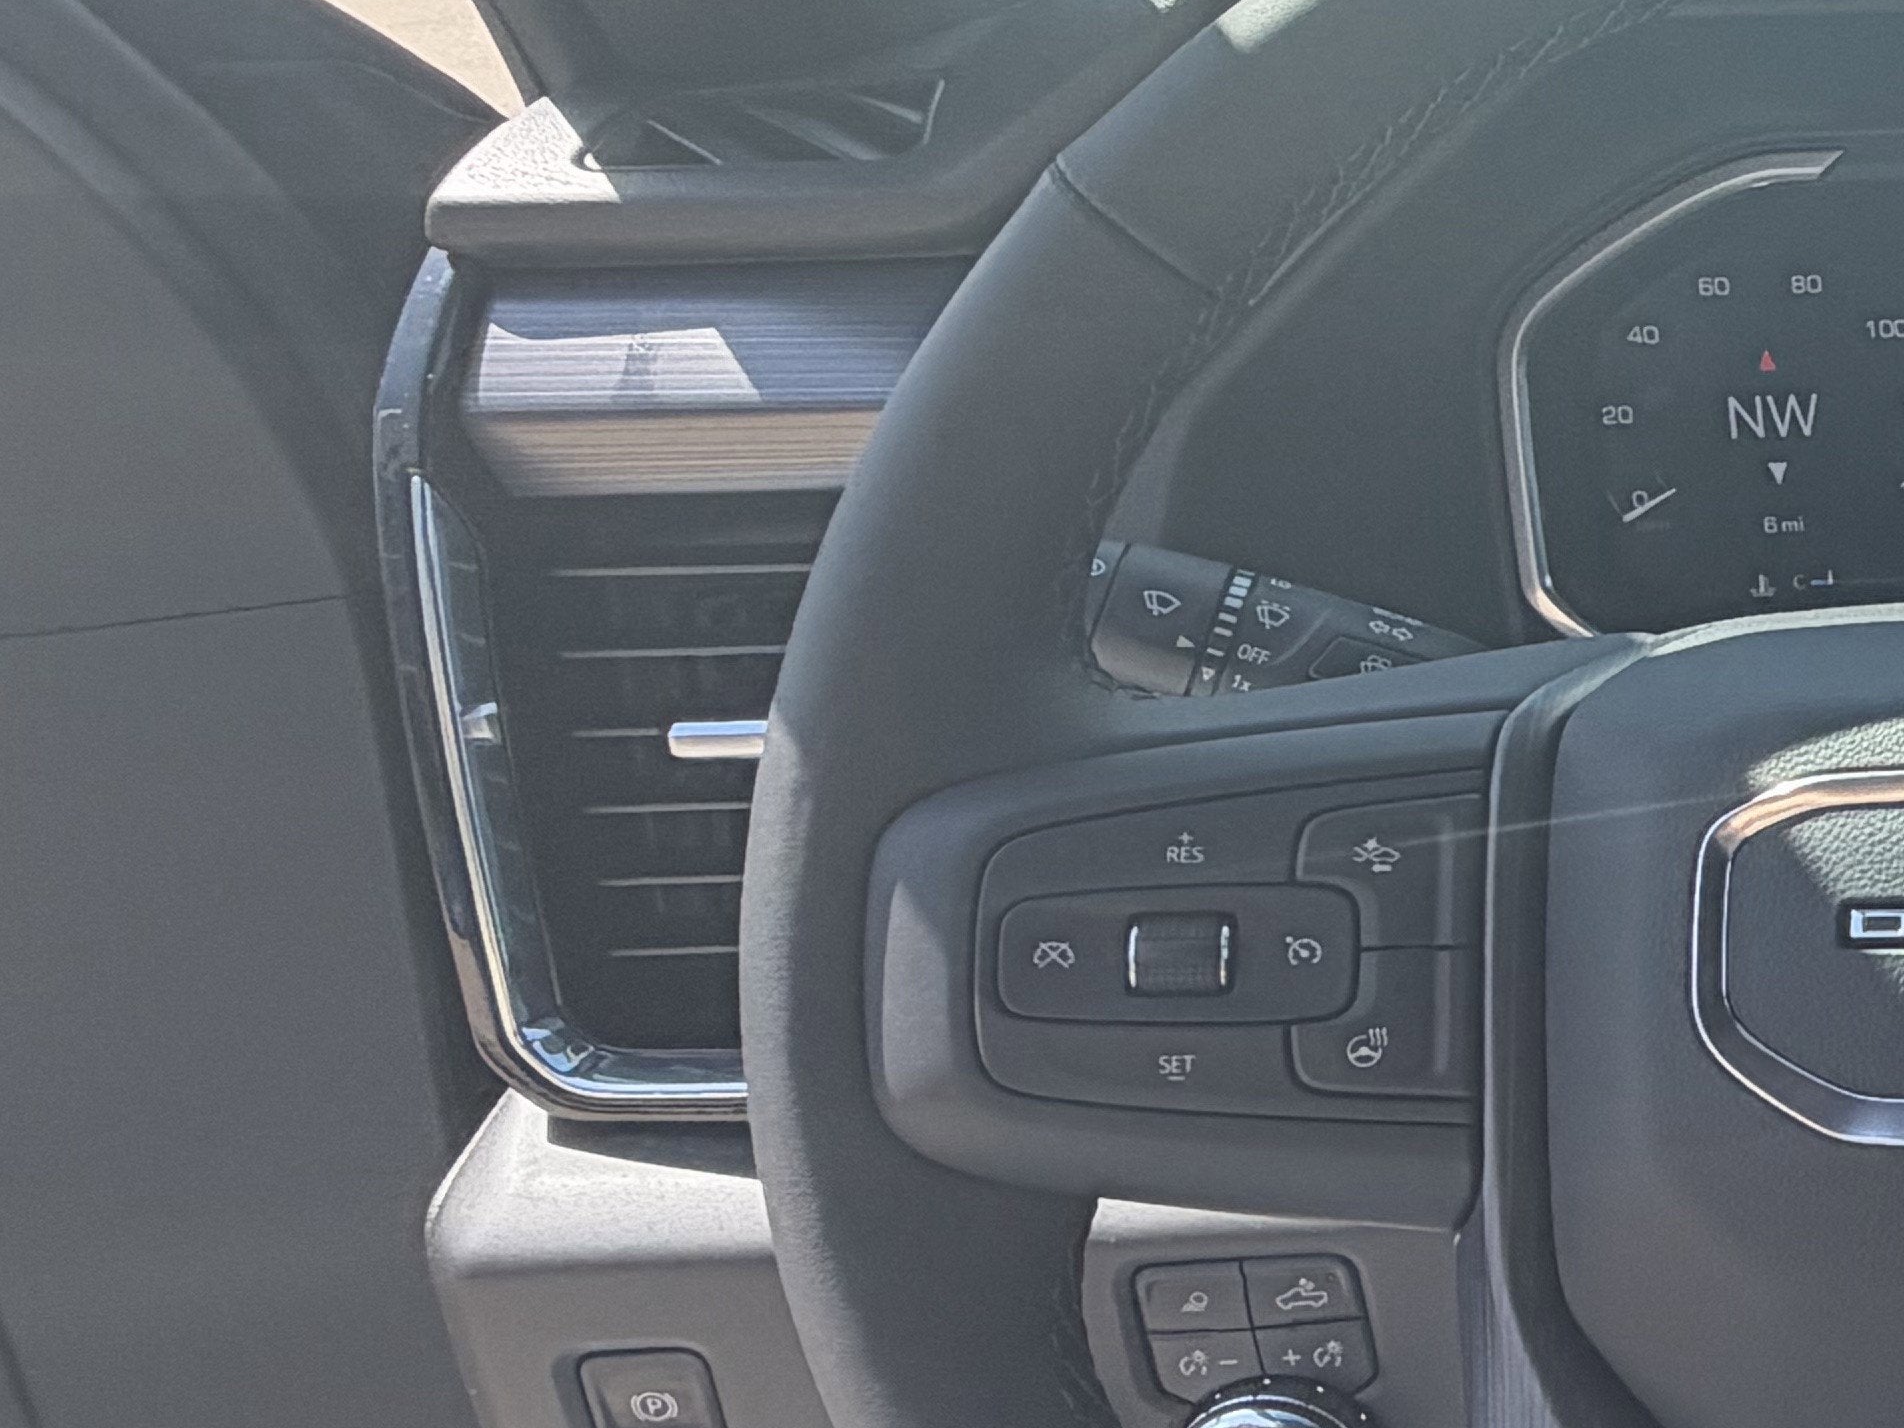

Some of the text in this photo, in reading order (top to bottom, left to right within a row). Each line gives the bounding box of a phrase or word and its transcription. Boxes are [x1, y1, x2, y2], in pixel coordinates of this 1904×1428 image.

[1698, 276, 1731, 297] 60
[1790, 274, 1823, 295] 80
[1626, 324, 1660, 345] 40
[1601, 405, 1634, 425] 20
[1727, 392, 1819, 440] NW
[1762, 515, 1806, 534] 6 mi
[1236, 643, 1271, 665] OFF
[1166, 846, 1206, 864] RES
[1158, 1055, 1196, 1075] SET
